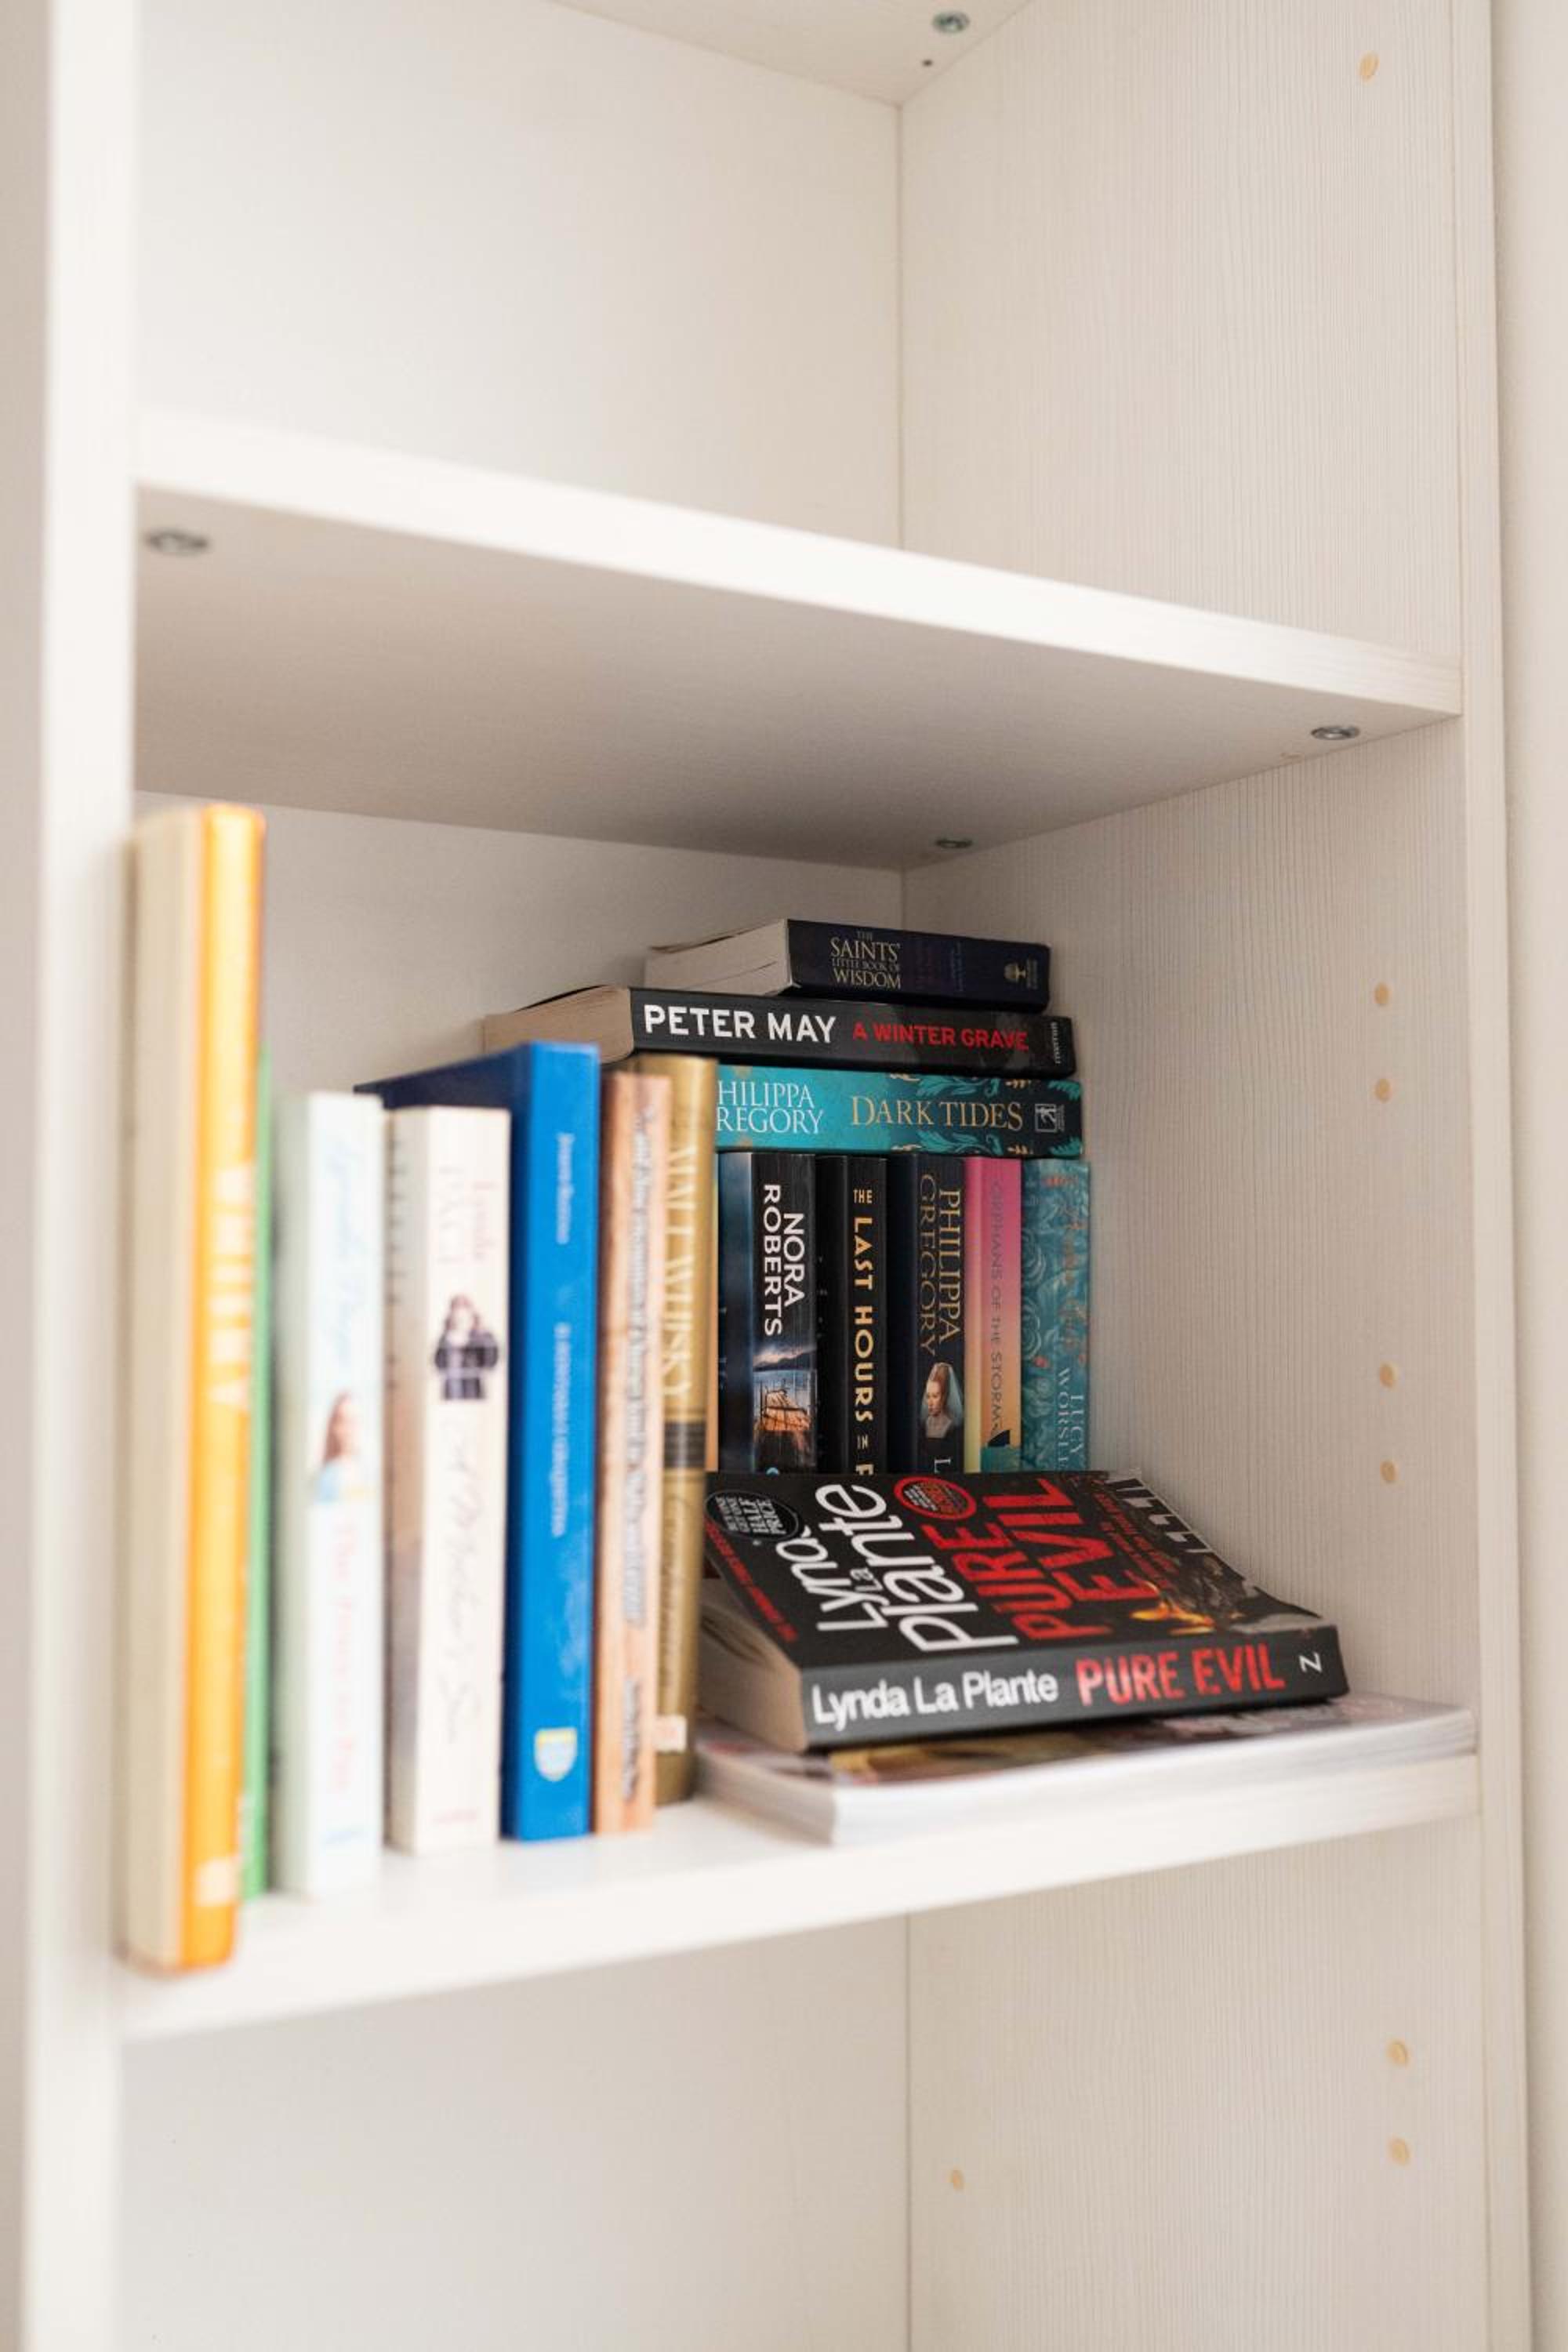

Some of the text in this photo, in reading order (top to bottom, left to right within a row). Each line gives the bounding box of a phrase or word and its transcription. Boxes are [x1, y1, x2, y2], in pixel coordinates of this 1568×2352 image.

[829, 936, 901, 963] SAINTS'
[833, 967, 902, 990] WISDOM
[643, 1004, 837, 1045] PETER MAY
[853, 1022, 869, 1041] A
[872, 1022, 955, 1046] WINTER
[960, 1028, 1029, 1051] GRAVE
[717, 1079, 815, 1109] HILIPPA
[851, 1095, 935, 1127] DARK
[938, 1098, 1024, 1132] TIDES
[715, 1106, 823, 1134] REGORY
[853, 1189, 873, 1204] THE
[853, 1217, 873, 1290] LAST
[990, 1180, 1004, 1281] ORPHANS
[762, 1183, 782, 1337] ROBERTS
[784, 1212, 806, 1308] NORA
[919, 1173, 936, 1358] GREGORY
[938, 1189, 961, 1343] PHILIPPA
[990, 1285, 1004, 1310] OF
[990, 1316, 1004, 1343] THE
[854, 1306, 874, 1423] HOURS
[856, 1434, 869, 1450] IN
[1071, 1394, 1084, 1455] LUCY
[738, 1496, 769, 1534] HALF
[755, 1498, 787, 1534] PRICE
[982, 1476, 1161, 1604] EVIL
[754, 1525, 889, 1631] Lynd
[814, 1483, 1021, 1653] Plante
[849, 1567, 884, 1593] La
[920, 1521, 1110, 1642] PURE
[811, 1668, 1059, 1731] Lynda La Plante
[1075, 1642, 1286, 1708] PURE EVIL
